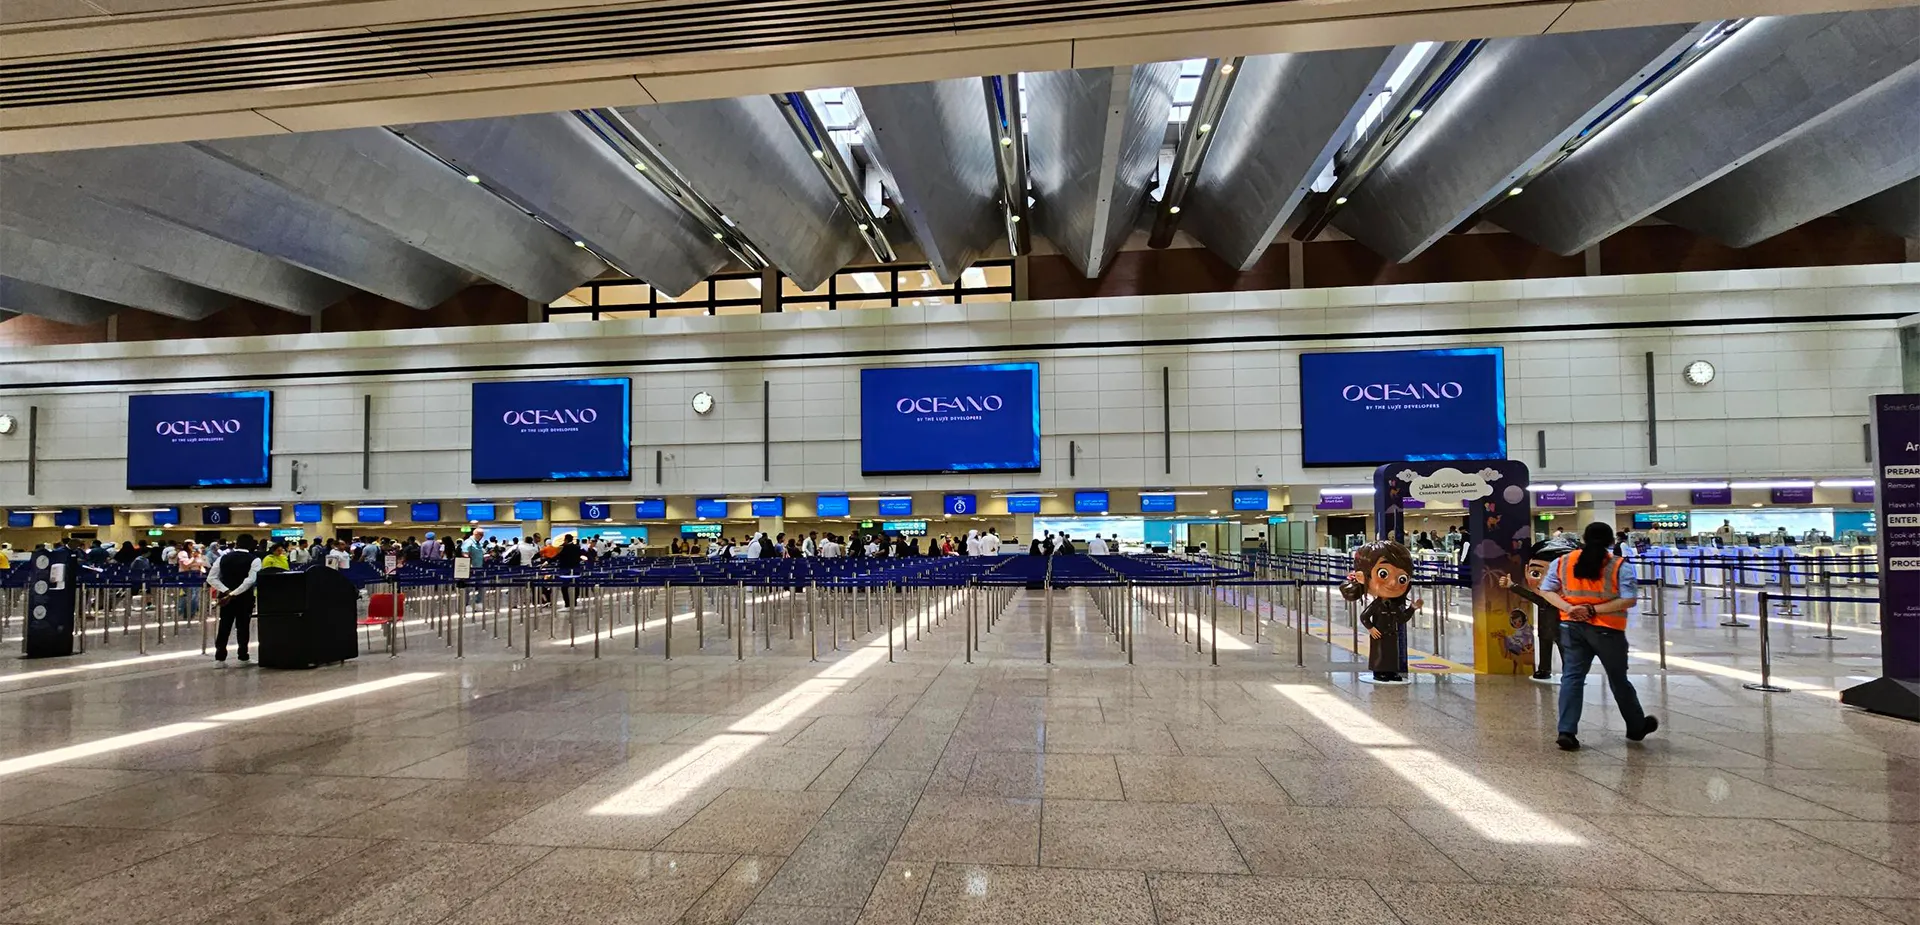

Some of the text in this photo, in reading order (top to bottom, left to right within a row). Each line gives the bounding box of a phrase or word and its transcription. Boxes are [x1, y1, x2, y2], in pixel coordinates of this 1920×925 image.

[1342, 381, 1463, 402] OCEANO
[896, 395, 1003, 414] OCEANO
[1883, 403, 1908, 411] Smart
[503, 408, 597, 425] OCEANO
[935, 415, 949, 423] LUXE
[156, 419, 241, 435] OCEANO
[1889, 516, 1918, 524] ENTER
[1890, 540, 1911, 548] green
[626, 549, 636, 557] 26
